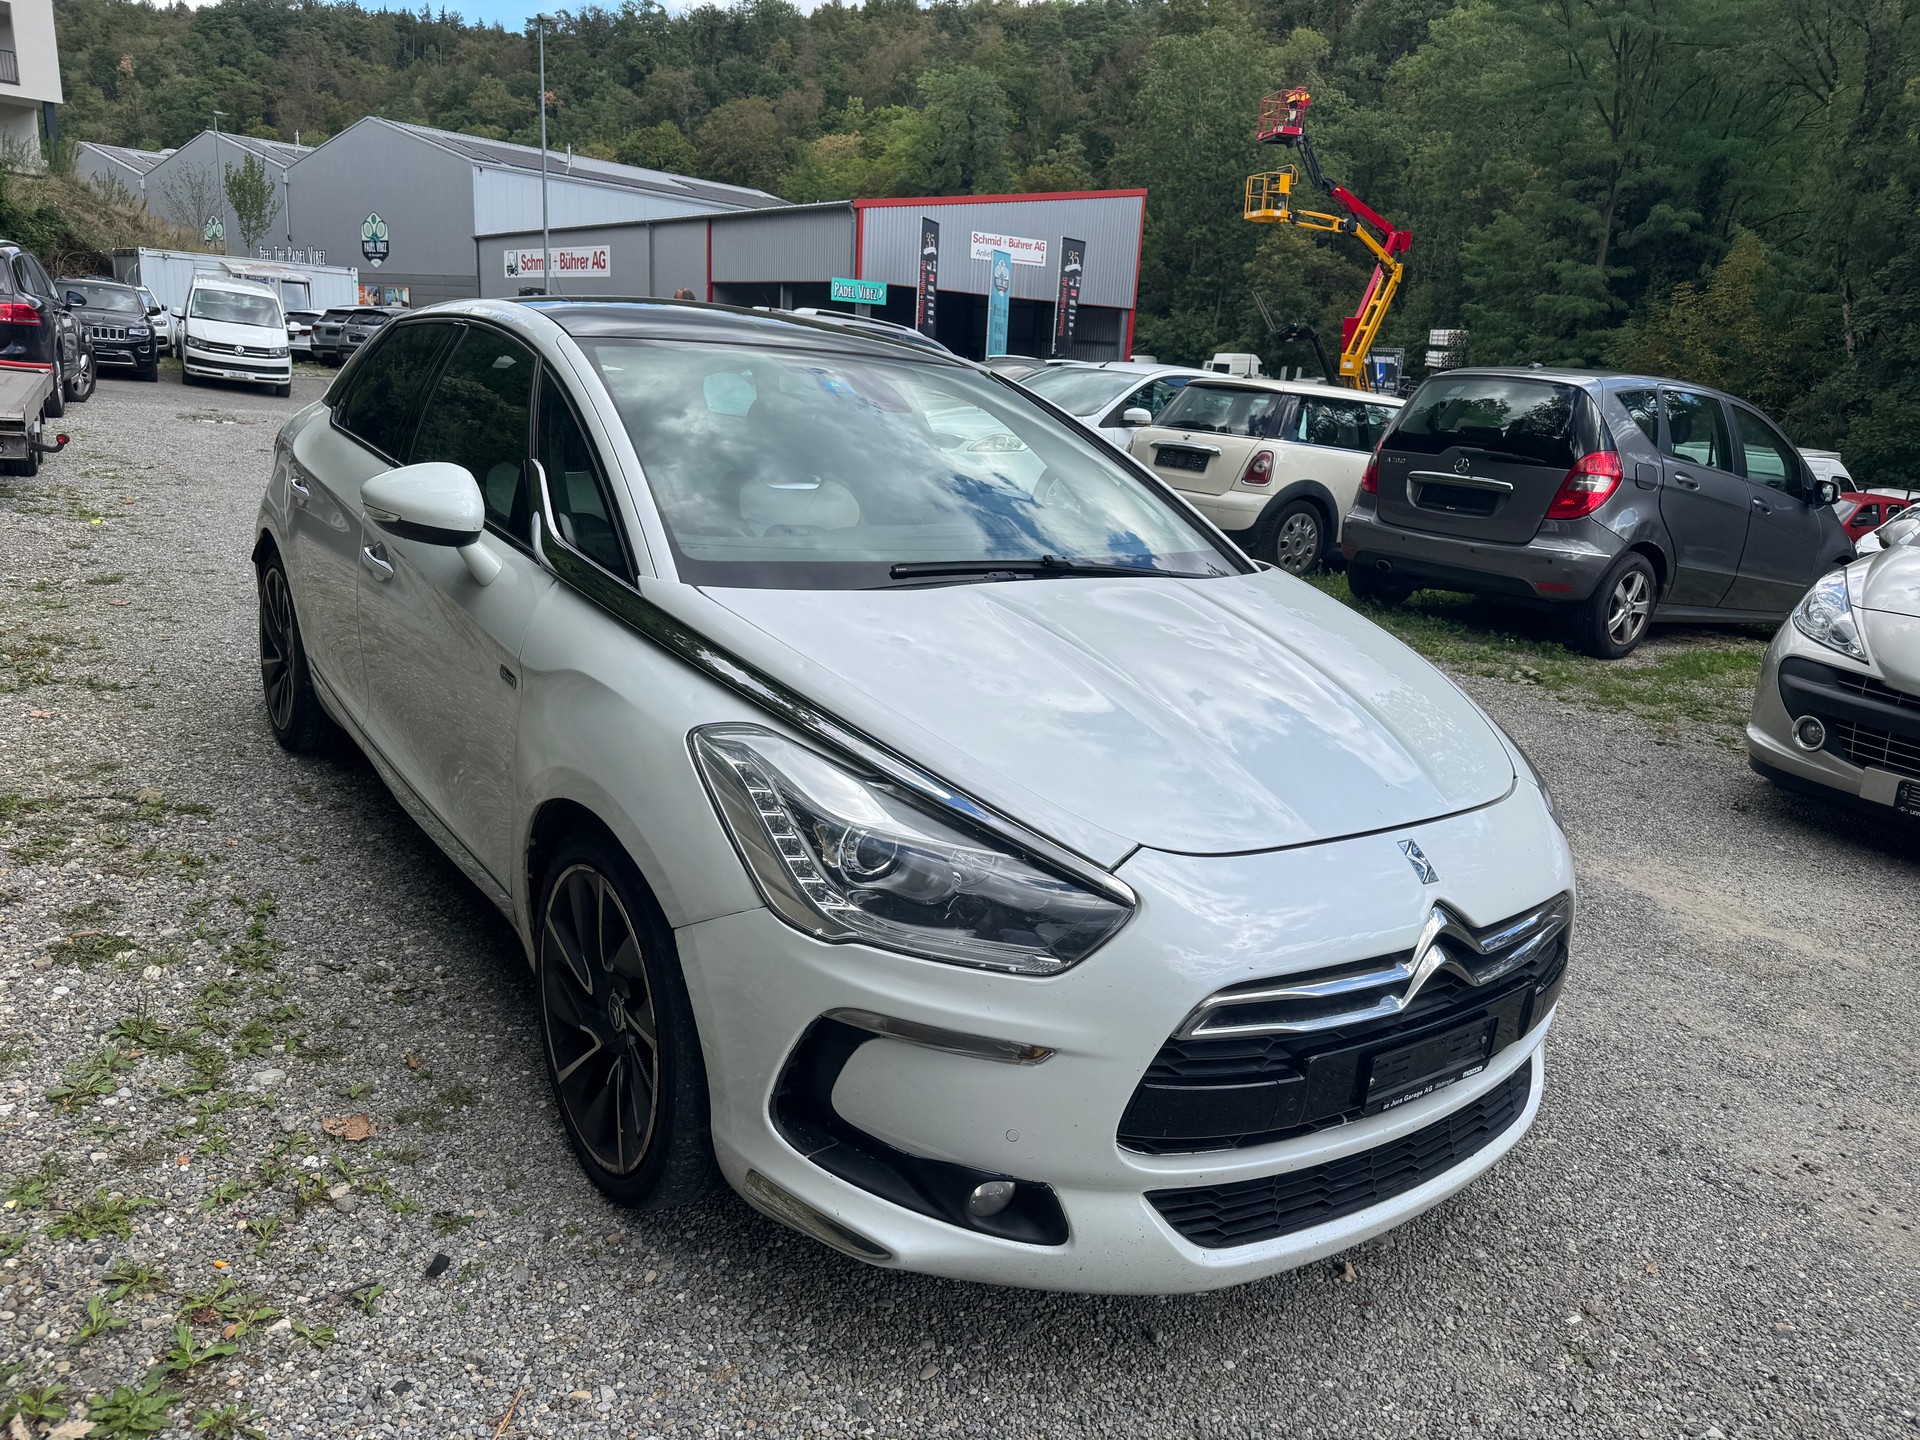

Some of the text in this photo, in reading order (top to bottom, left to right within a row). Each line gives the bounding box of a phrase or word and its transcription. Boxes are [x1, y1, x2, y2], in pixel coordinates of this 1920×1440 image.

[973, 233, 1002, 247] Schmid
[1008, 238, 1033, 250] Bührer
[1034, 241, 1046, 252] AG
[560, 252, 590, 270] Bührer
[591, 250, 607, 269] AG
[1068, 250, 1080, 264] 35
[1403, 1090, 1423, 1102] Garage
[1423, 1085, 1433, 1094] AG
